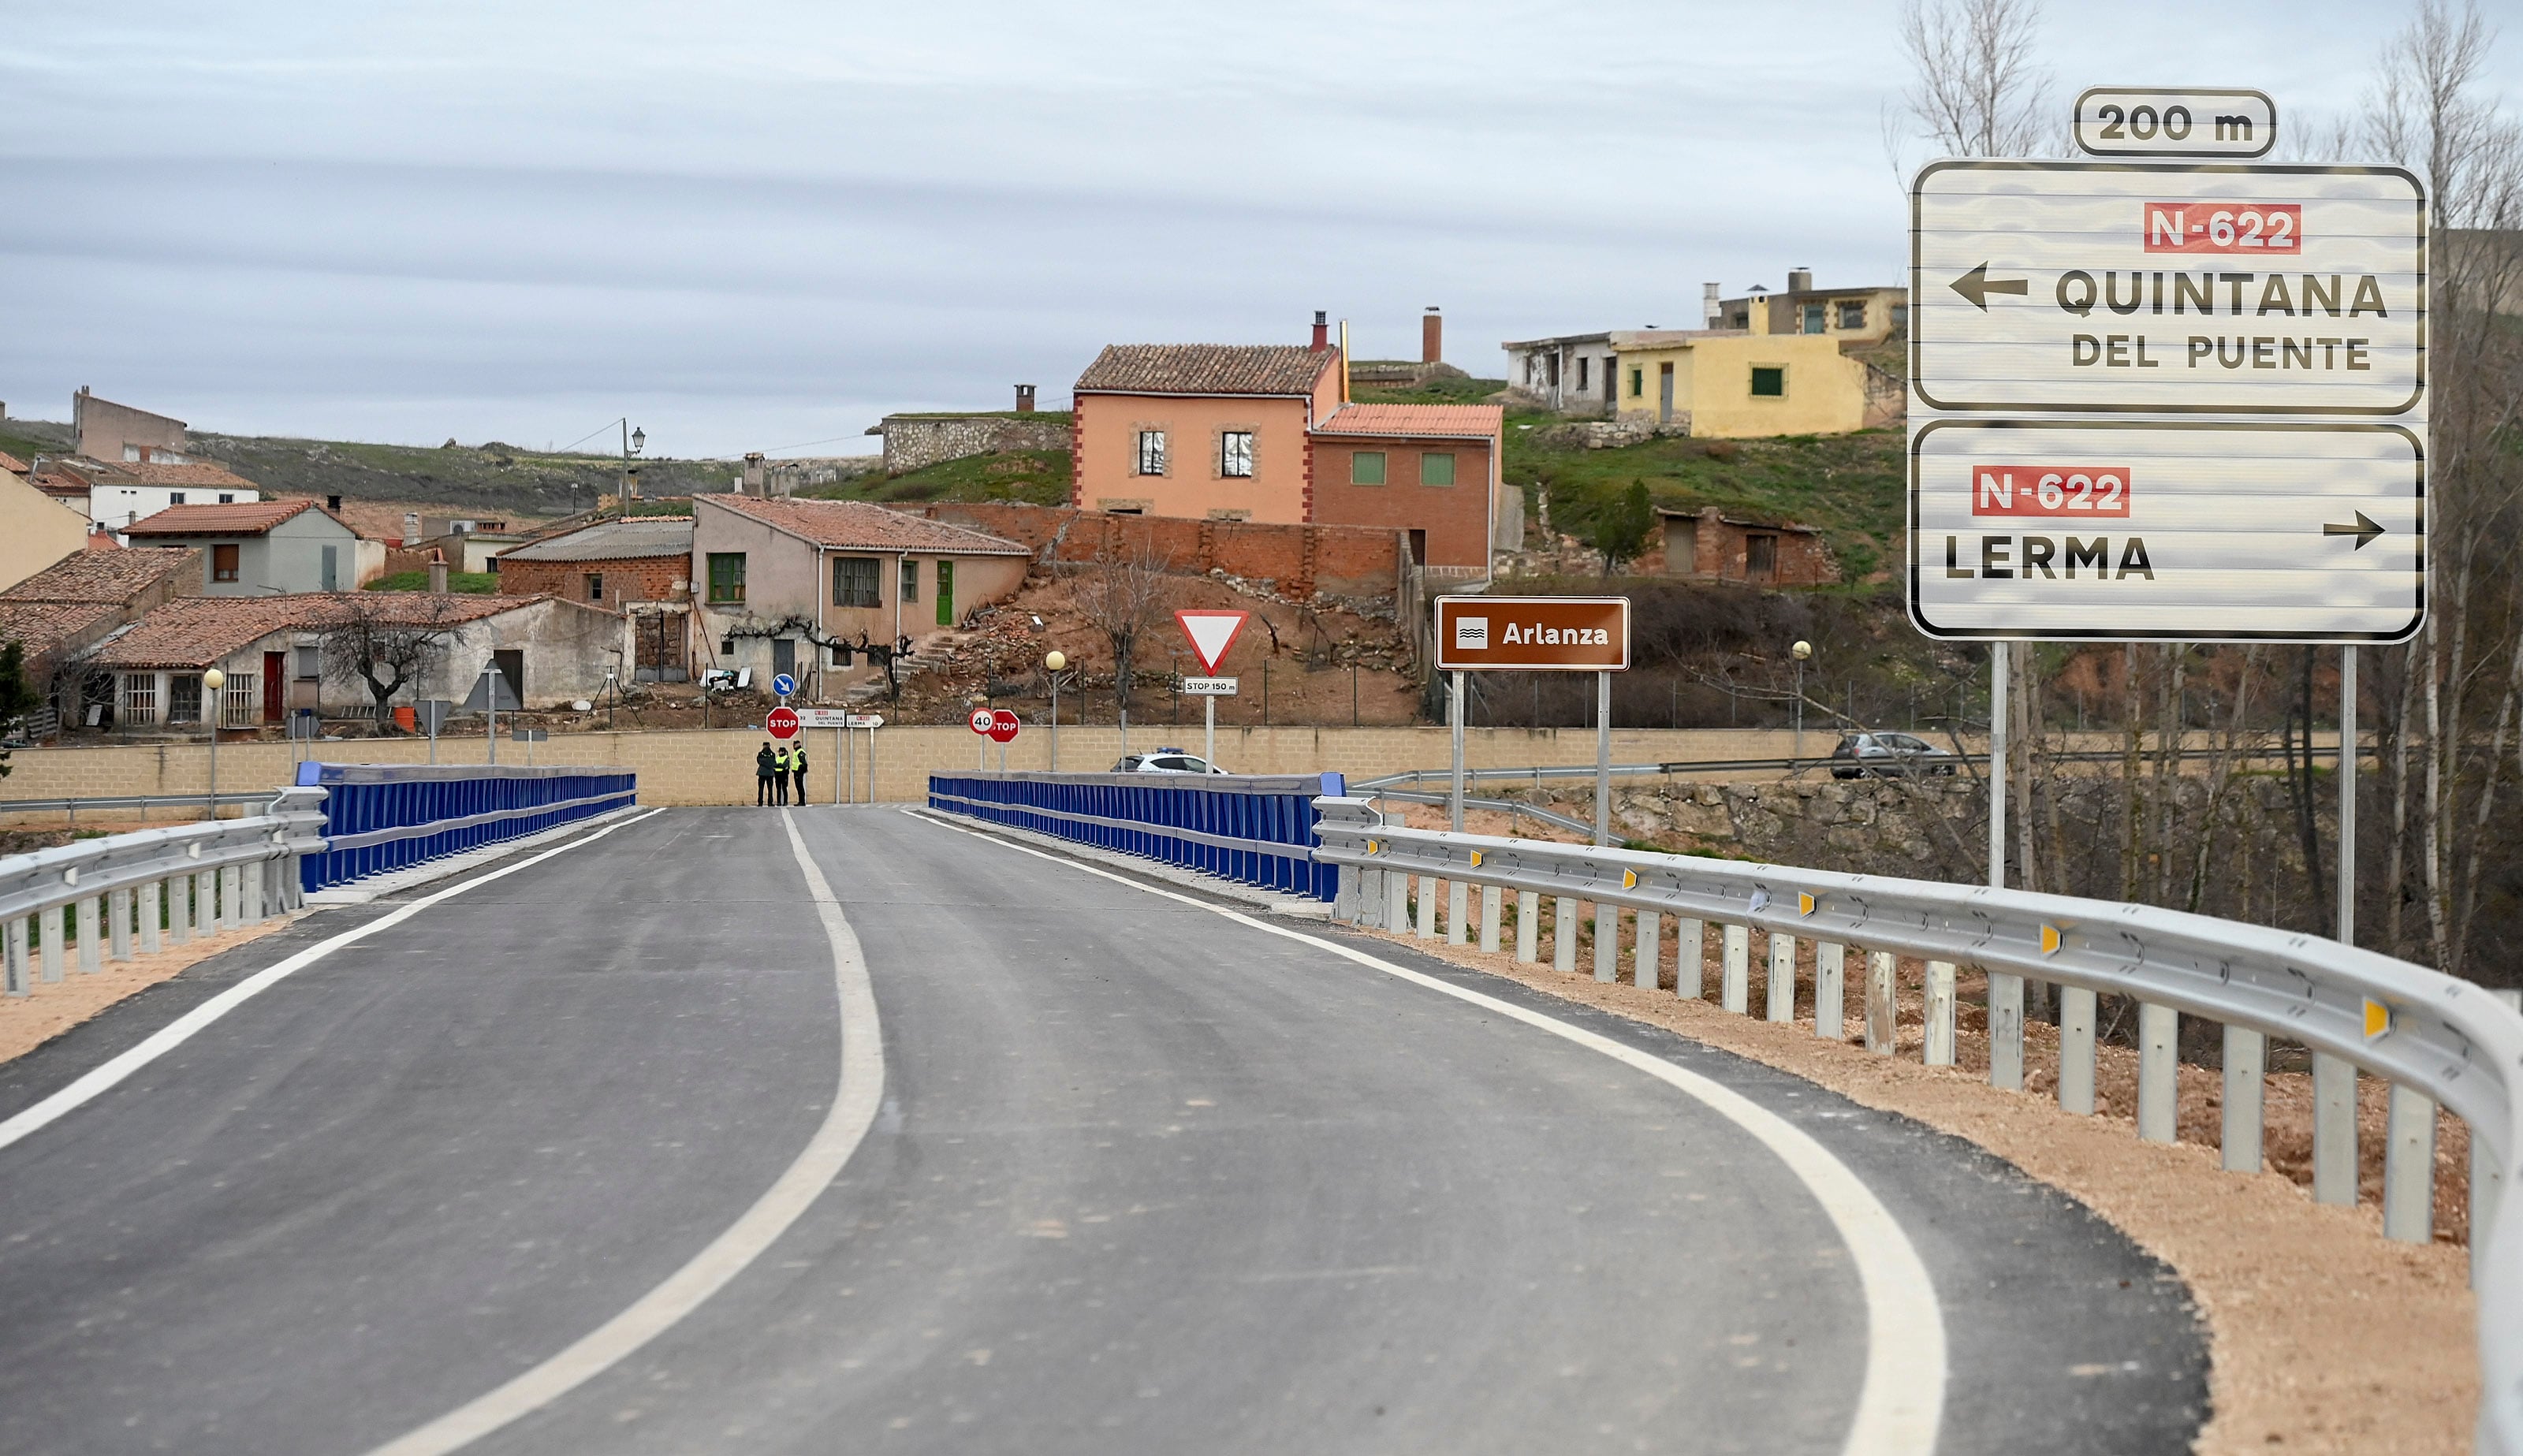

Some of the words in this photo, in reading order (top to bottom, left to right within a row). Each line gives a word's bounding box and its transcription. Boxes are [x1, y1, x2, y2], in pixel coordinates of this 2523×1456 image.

[2098, 105, 2193, 141] 200
[2215, 113, 2253, 142] m
[2150, 210, 2295, 248] N-622
[2055, 269, 2388, 319] QUINTANA
[2072, 334, 2159, 368] DEL
[2188, 337, 2371, 371] PUENTE
[1979, 473, 2123, 510] N-622
[1945, 535, 2155, 580] LERMA
[1502, 622, 1609, 646] Arlanza
